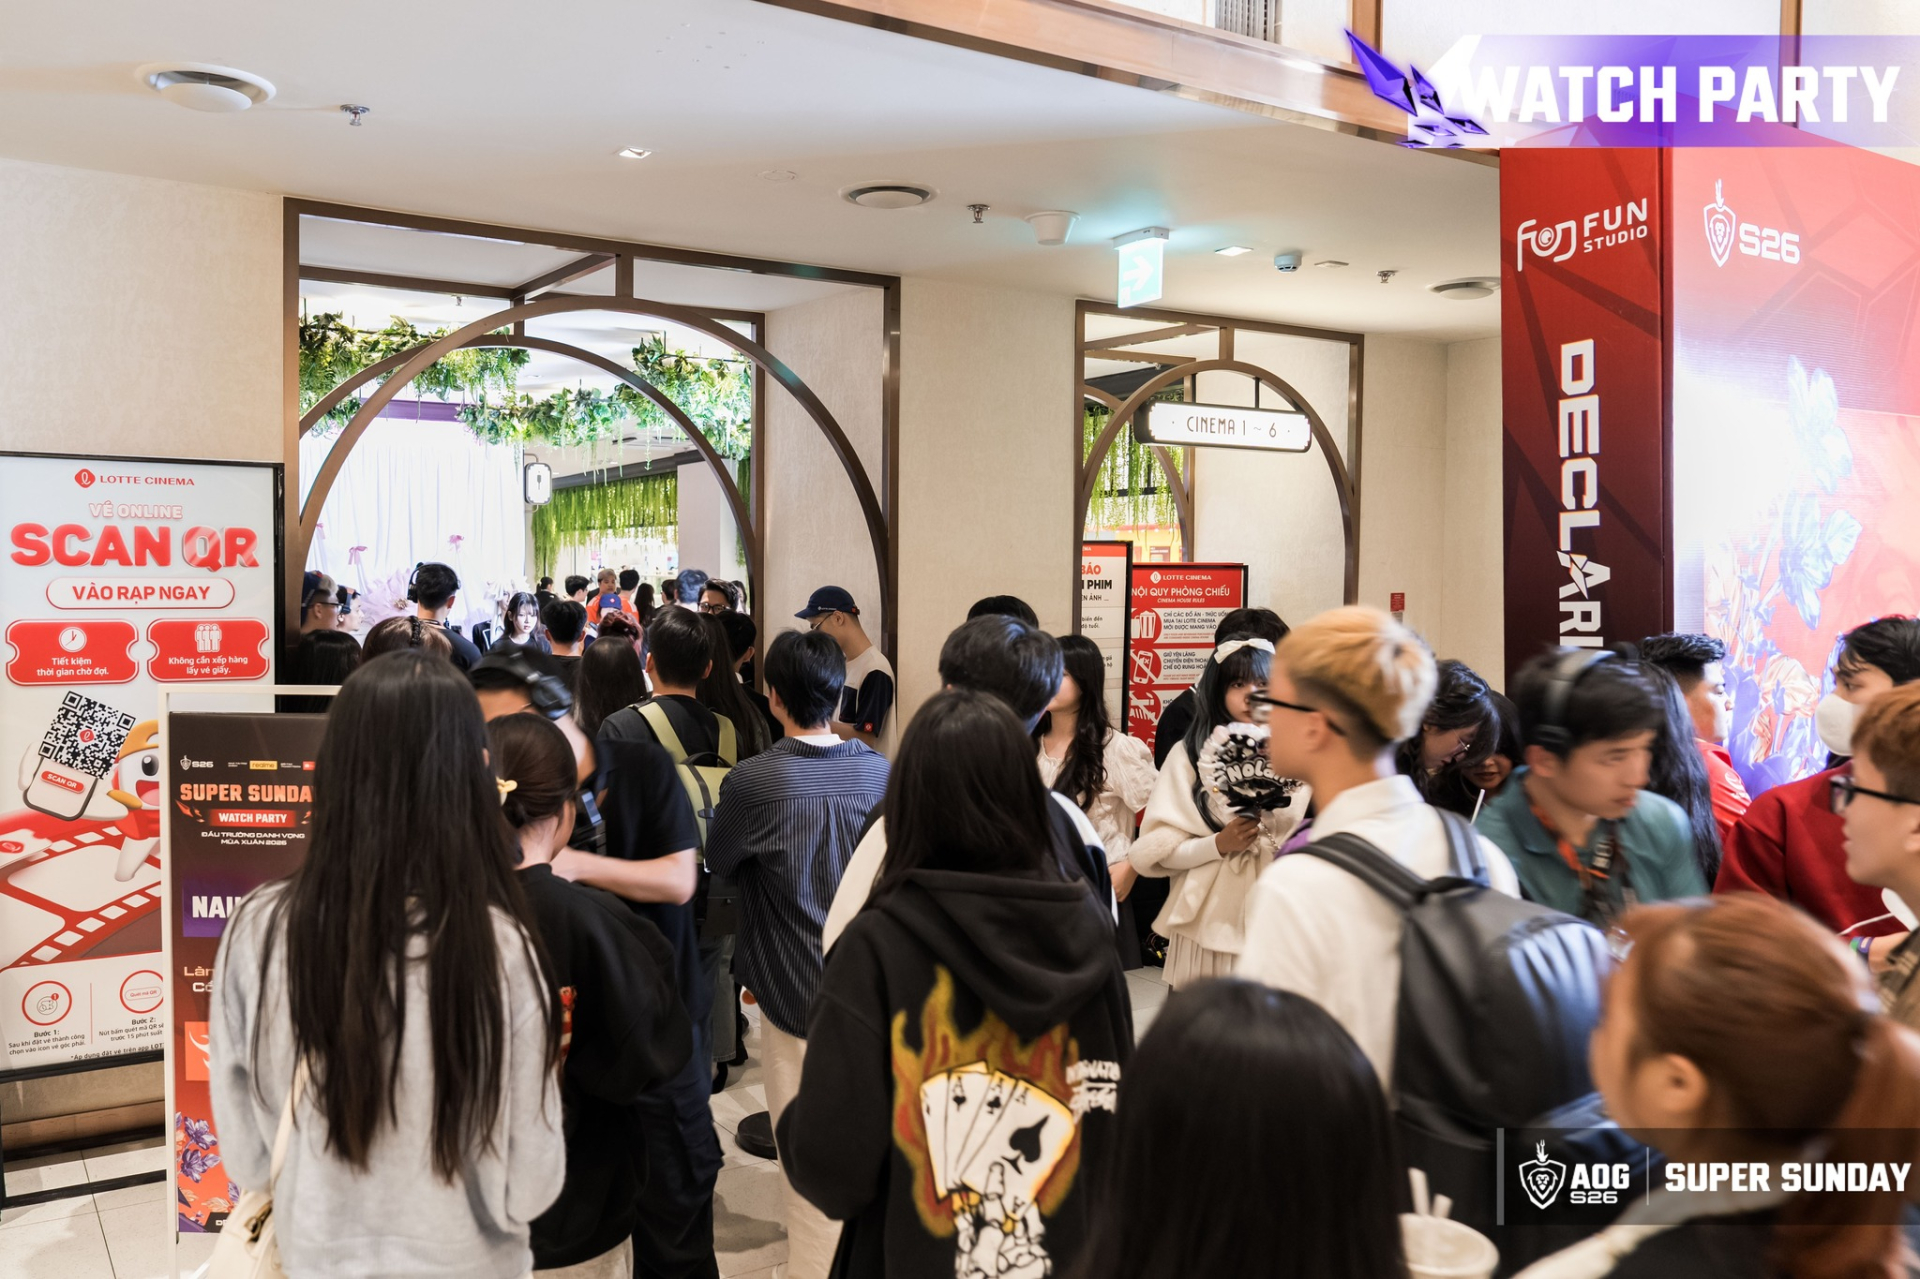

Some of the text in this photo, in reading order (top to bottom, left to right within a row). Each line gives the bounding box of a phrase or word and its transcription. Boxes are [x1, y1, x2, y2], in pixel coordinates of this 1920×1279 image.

[1584, 198, 1647, 237] FUN
[1584, 225, 1647, 253] STUDIO
[1739, 225, 1800, 264] S26
[1187, 416, 1235, 435] CINEMA
[1269, 423, 1276, 438] 6
[100, 476, 194, 486] LOTTE CINEMA
[89, 500, 183, 519] VÉ ONLINE
[10, 522, 260, 572] SCAN QR
[1087, 580, 1112, 589] PHIM
[1132, 584, 1230, 598] NỘI QUY PHÒNG CHIẾU
[73, 582, 210, 604] VÀO RẠP NGAY
[52, 657, 91, 666] Tiết kiệm
[169, 657, 194, 665] Không
[212, 655, 226, 664] xếp
[229, 656, 248, 664] hàng
[37, 668, 54, 676] thời
[56, 668, 74, 677] gian
[77, 667, 92, 675] chờ
[187, 666, 198, 675] lấy
[47, 774, 77, 789] SCAN QR
[180, 784, 314, 802] SUPER SUNDA
[219, 813, 287, 823] WATCH PARTY
